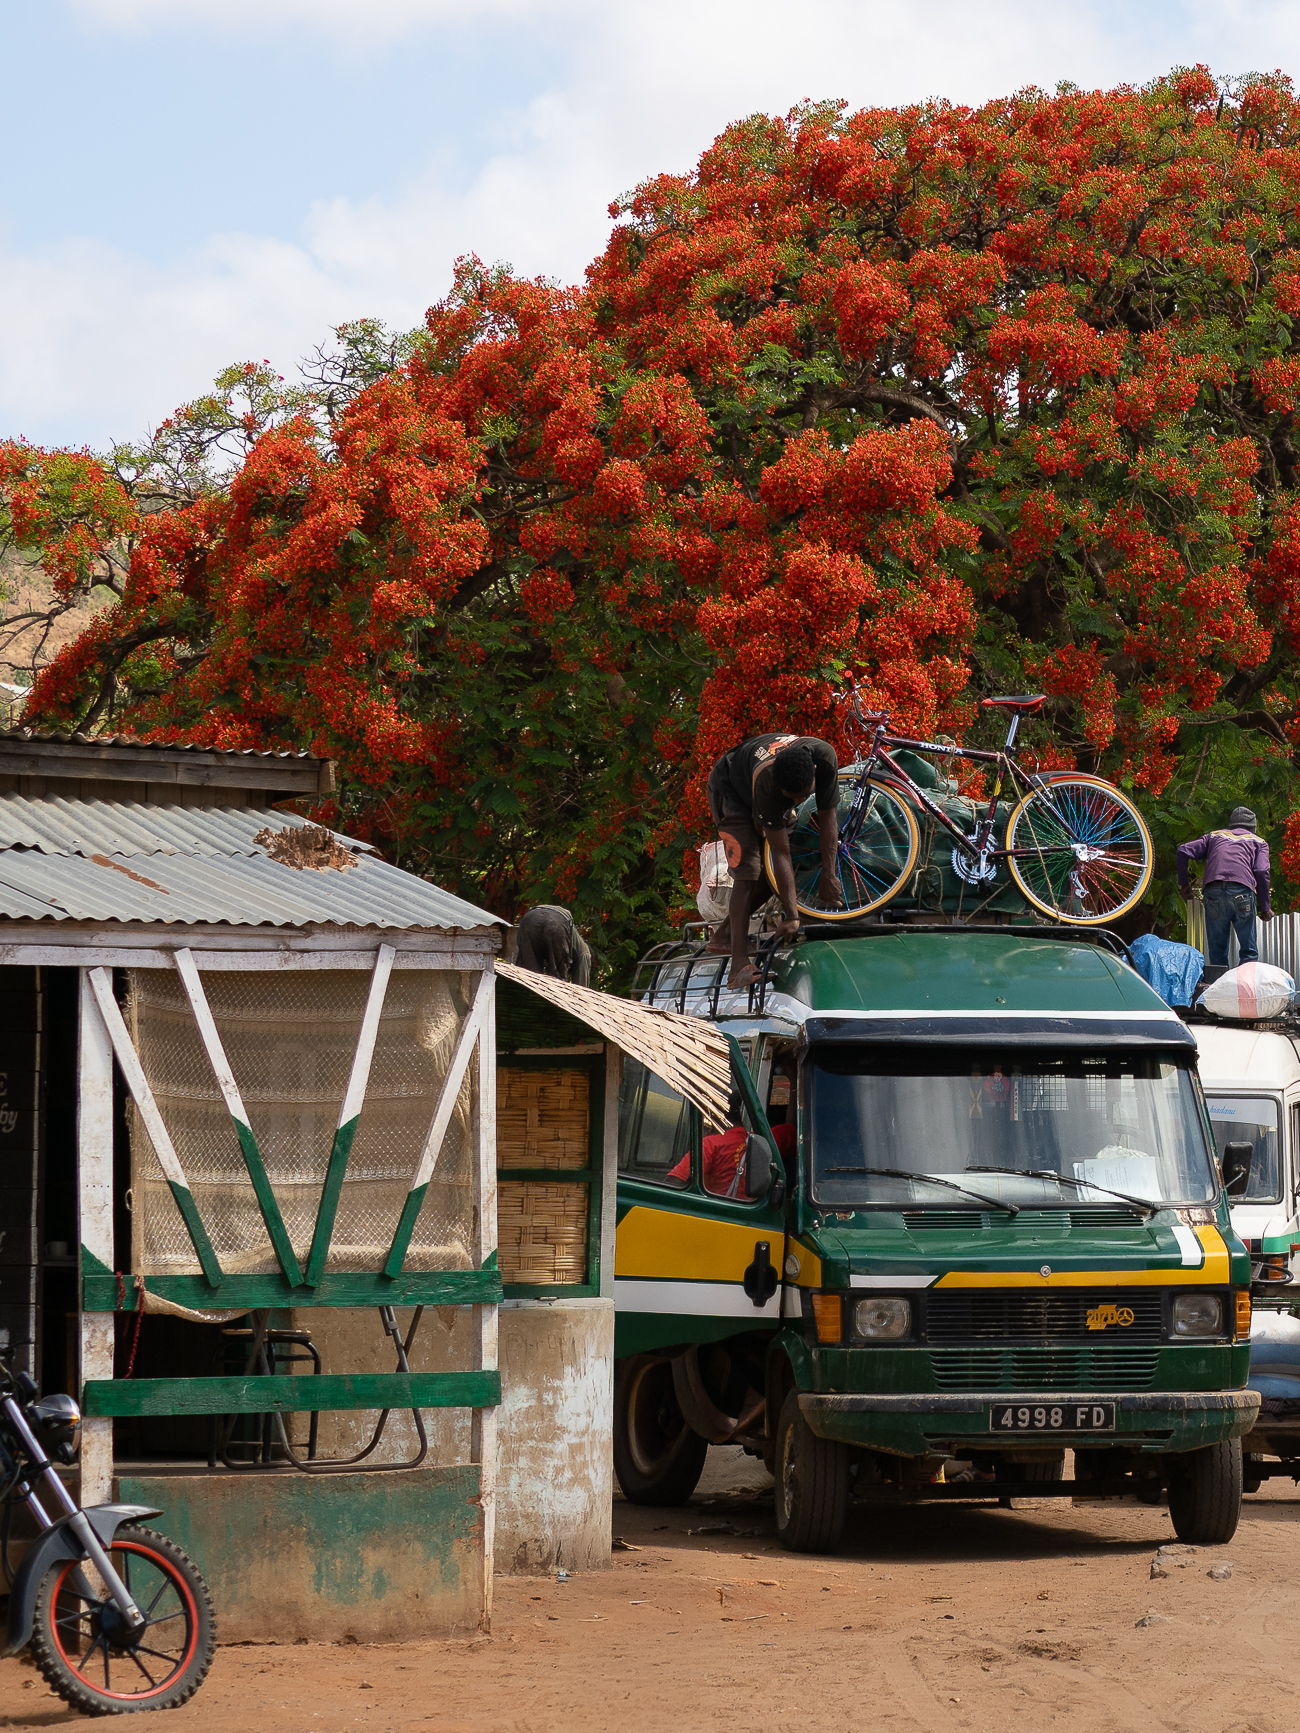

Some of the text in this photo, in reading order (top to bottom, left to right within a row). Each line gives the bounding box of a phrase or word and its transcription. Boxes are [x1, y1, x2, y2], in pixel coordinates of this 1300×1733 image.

[919, 742, 964, 755] HONDA
[1001, 1407, 1105, 1428] 4998 FD
